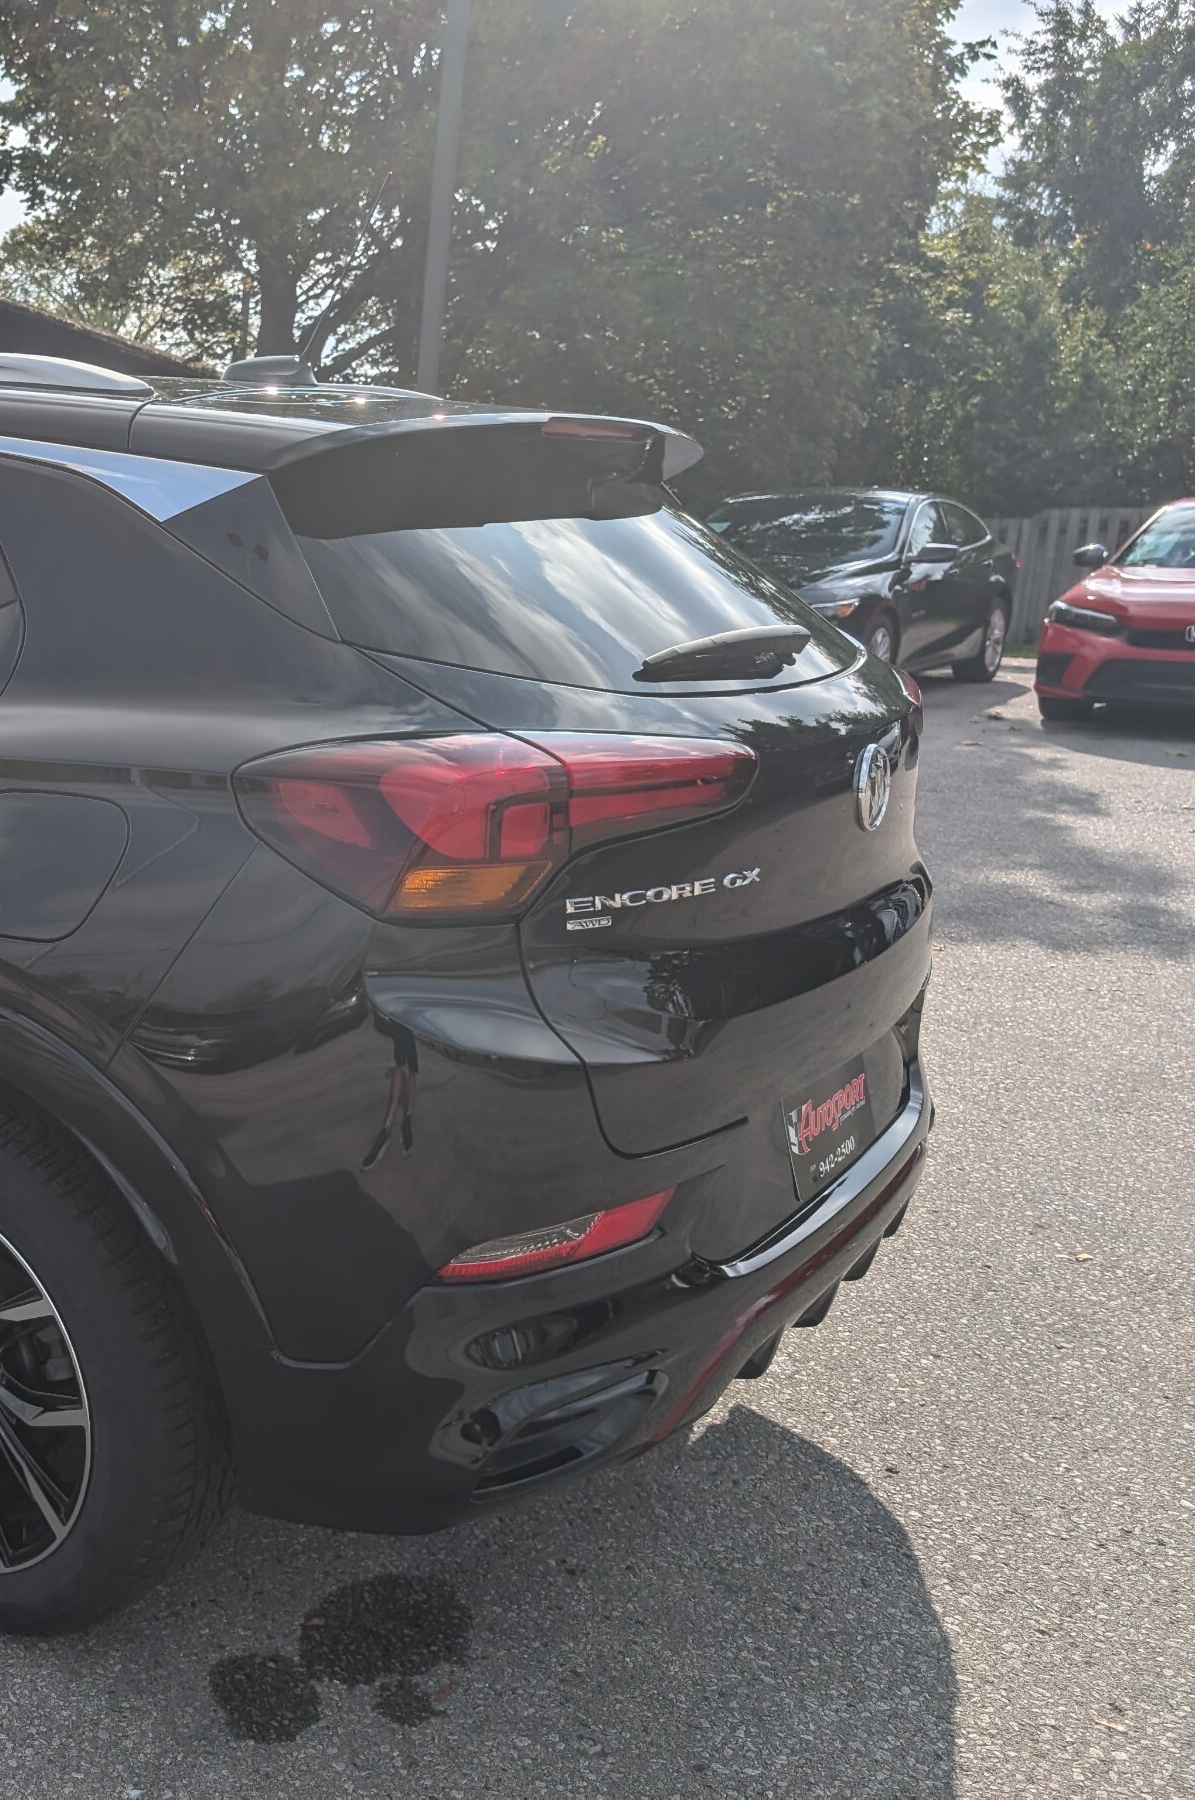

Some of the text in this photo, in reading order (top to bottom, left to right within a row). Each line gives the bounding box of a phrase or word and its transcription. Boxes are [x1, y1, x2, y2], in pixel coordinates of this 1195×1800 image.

[565, 867, 761, 914] ENCORE GX
[567, 916, 612, 930] AWD
[818, 1135, 855, 1178] 942-2500
